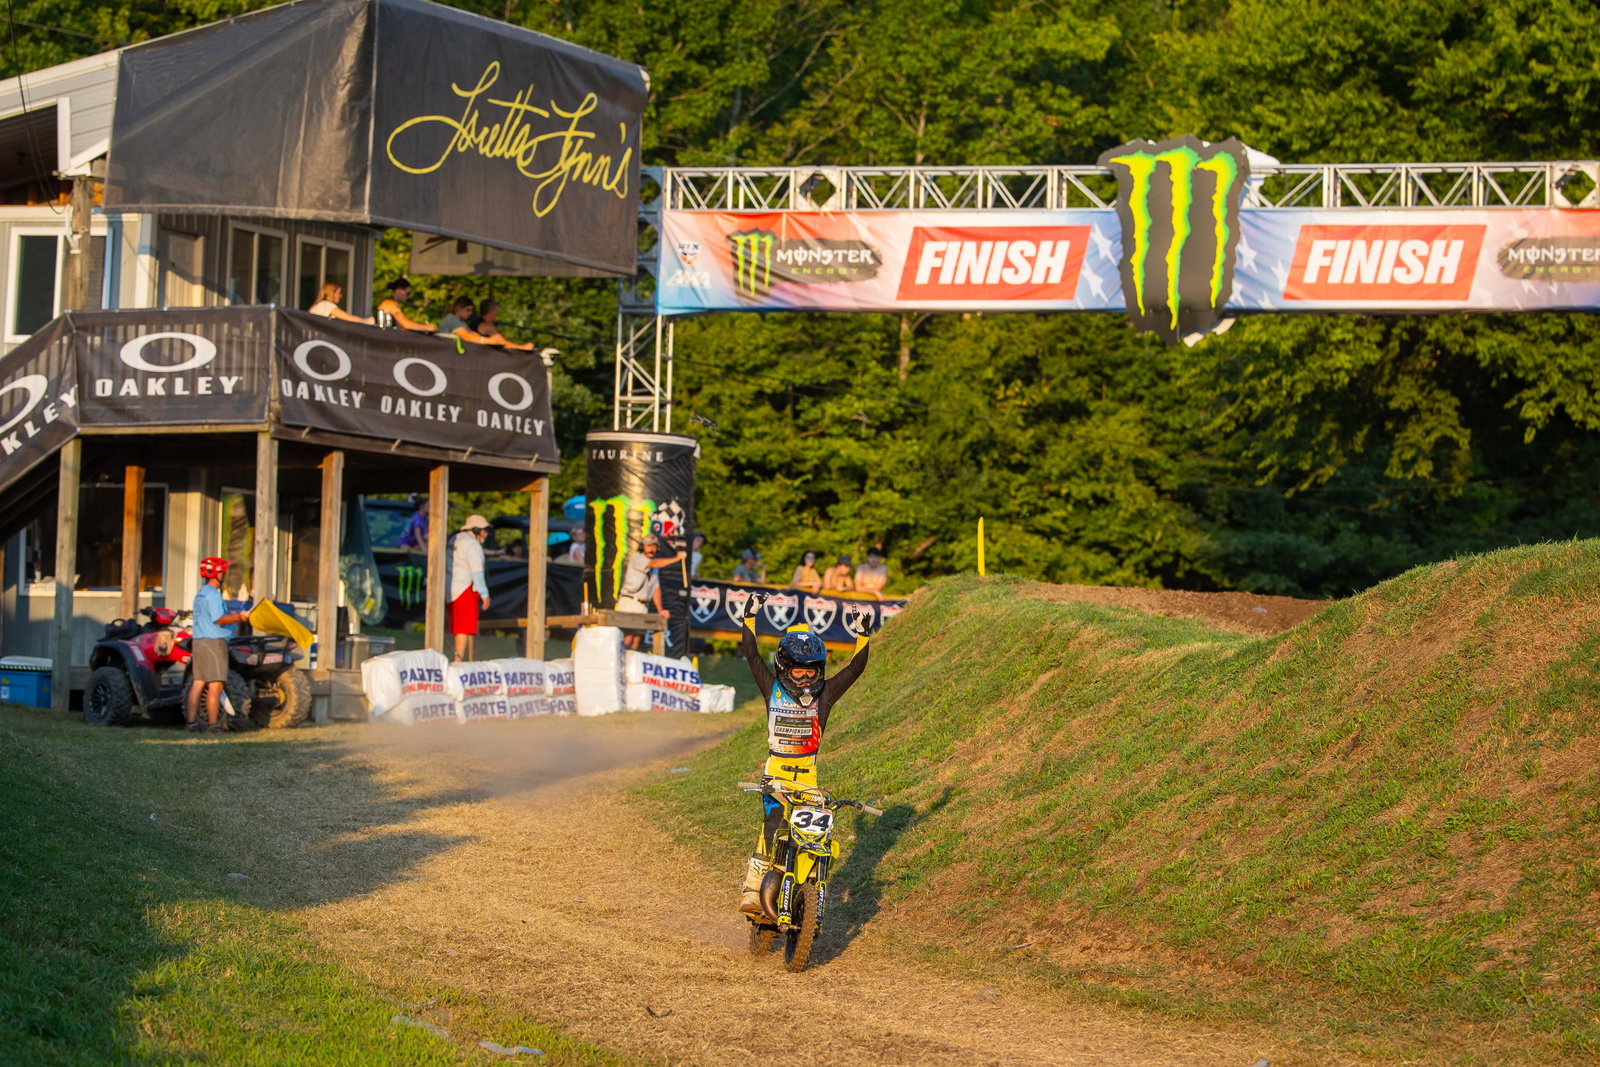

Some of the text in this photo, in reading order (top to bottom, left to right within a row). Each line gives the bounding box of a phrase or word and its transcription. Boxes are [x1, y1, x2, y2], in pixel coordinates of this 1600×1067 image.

[386, 60, 633, 218] Loretta Lynn's
[776, 246, 874, 265] MONSTER
[914, 239, 1071, 285] FINISH
[1302, 239, 1465, 285] FINISH
[790, 267, 859, 275] ENERGY
[95, 376, 239, 398] OAKLEY
[281, 379, 363, 409] OAKLEY
[380, 395, 460, 424] OAKLEY
[476, 409, 545, 437] OAKLEY
[592, 449, 664, 463] TAURINE
[400, 668, 444, 684] PARTS
[459, 671, 502, 687] PARTS
[504, 672, 544, 686] PARTS
[641, 662, 701, 684] PARTS
[642, 676, 700, 694] UNLIMITED
[412, 703, 457, 720] PARTS
[463, 701, 507, 719] PARTS
[793, 811, 831, 832] 34
